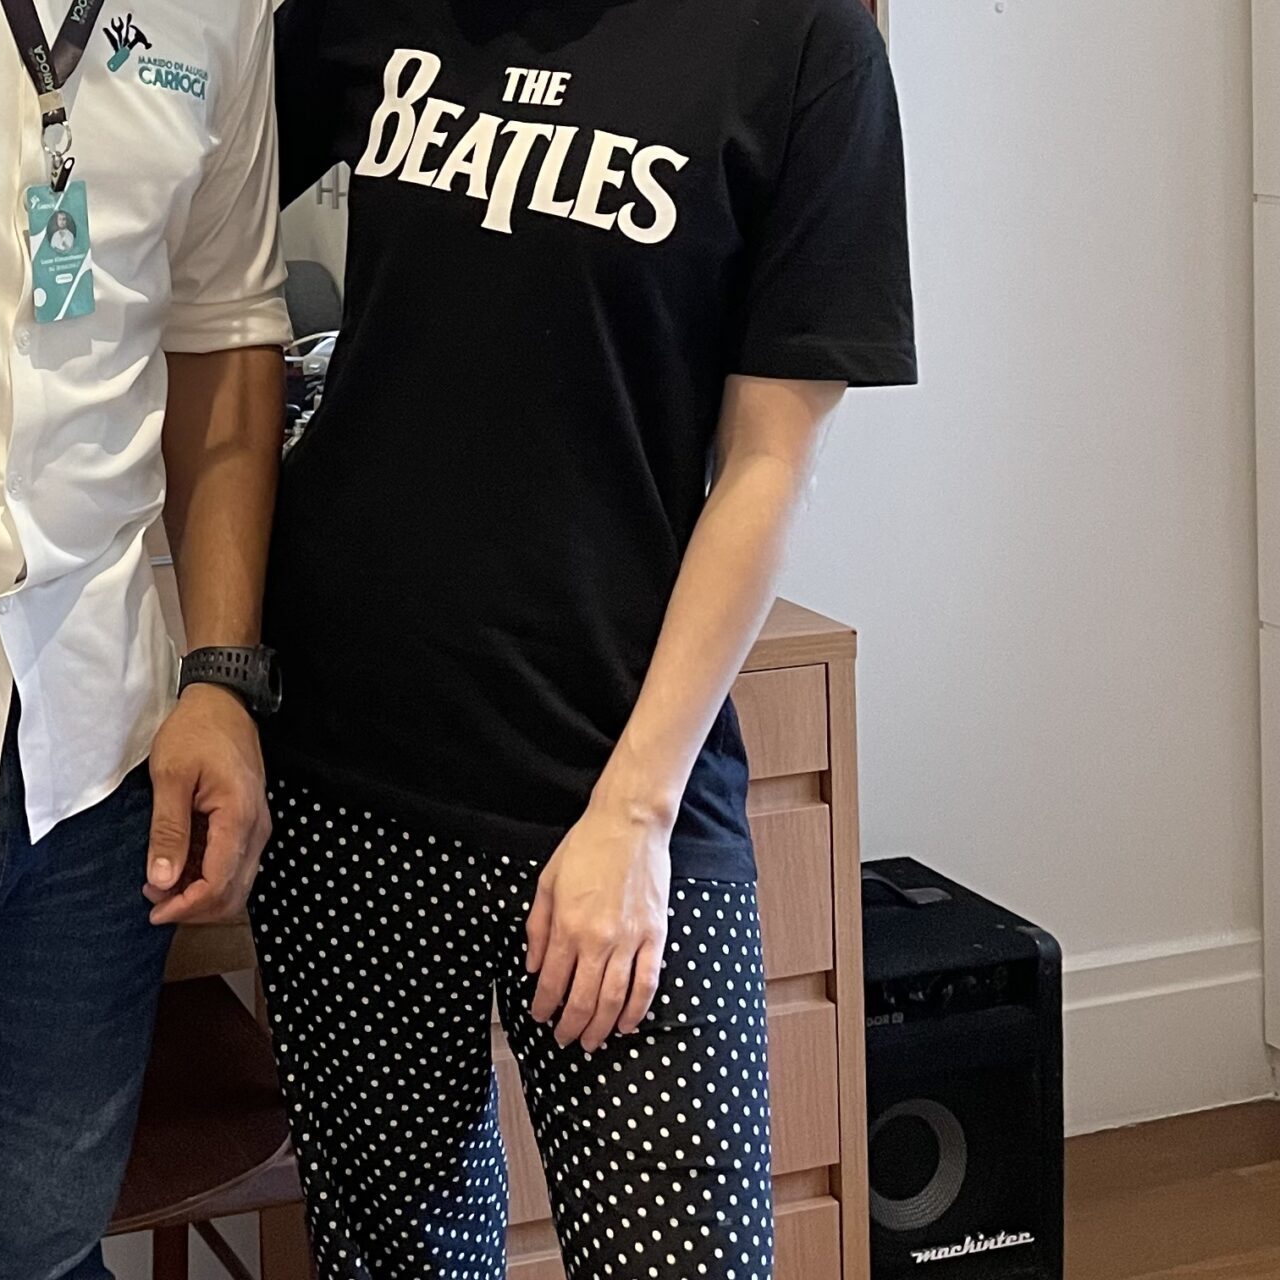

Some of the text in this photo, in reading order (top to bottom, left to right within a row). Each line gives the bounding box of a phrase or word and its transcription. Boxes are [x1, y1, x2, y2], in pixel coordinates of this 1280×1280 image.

[33, 44, 56, 92] ARIOCA
[138, 65, 206, 101] CARIOCA
[502, 66, 572, 107] THE
[354, 48, 690, 244] BEATLES
